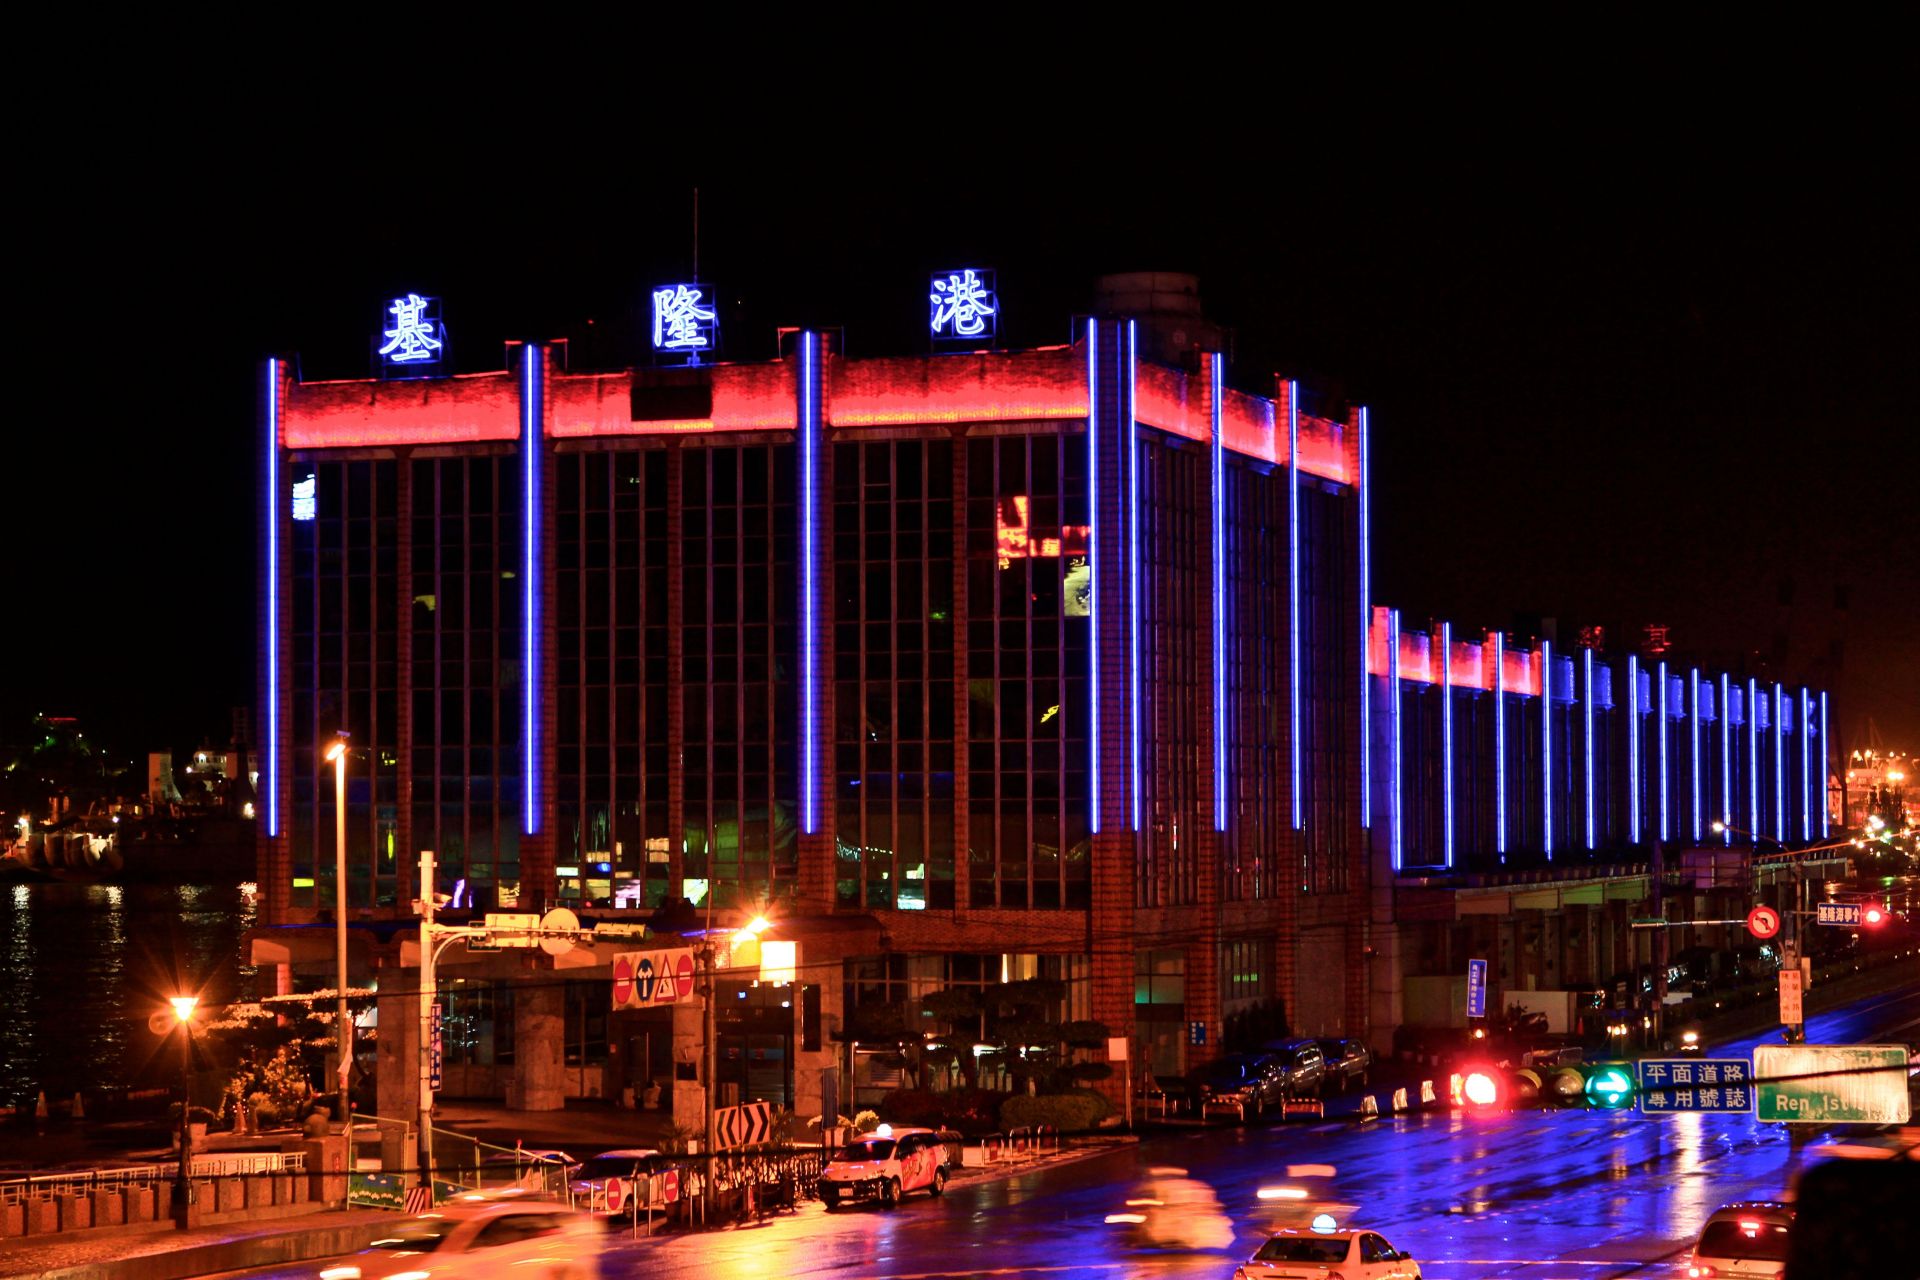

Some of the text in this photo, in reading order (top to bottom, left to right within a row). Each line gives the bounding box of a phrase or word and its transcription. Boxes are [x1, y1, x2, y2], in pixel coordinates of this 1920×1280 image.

[1646, 1063, 1745, 1084] 平面道路
[1647, 1087, 1747, 1108] 專用號誌
[1776, 1094, 1810, 1111] Ren
[1823, 1094, 1849, 1111] 1st
